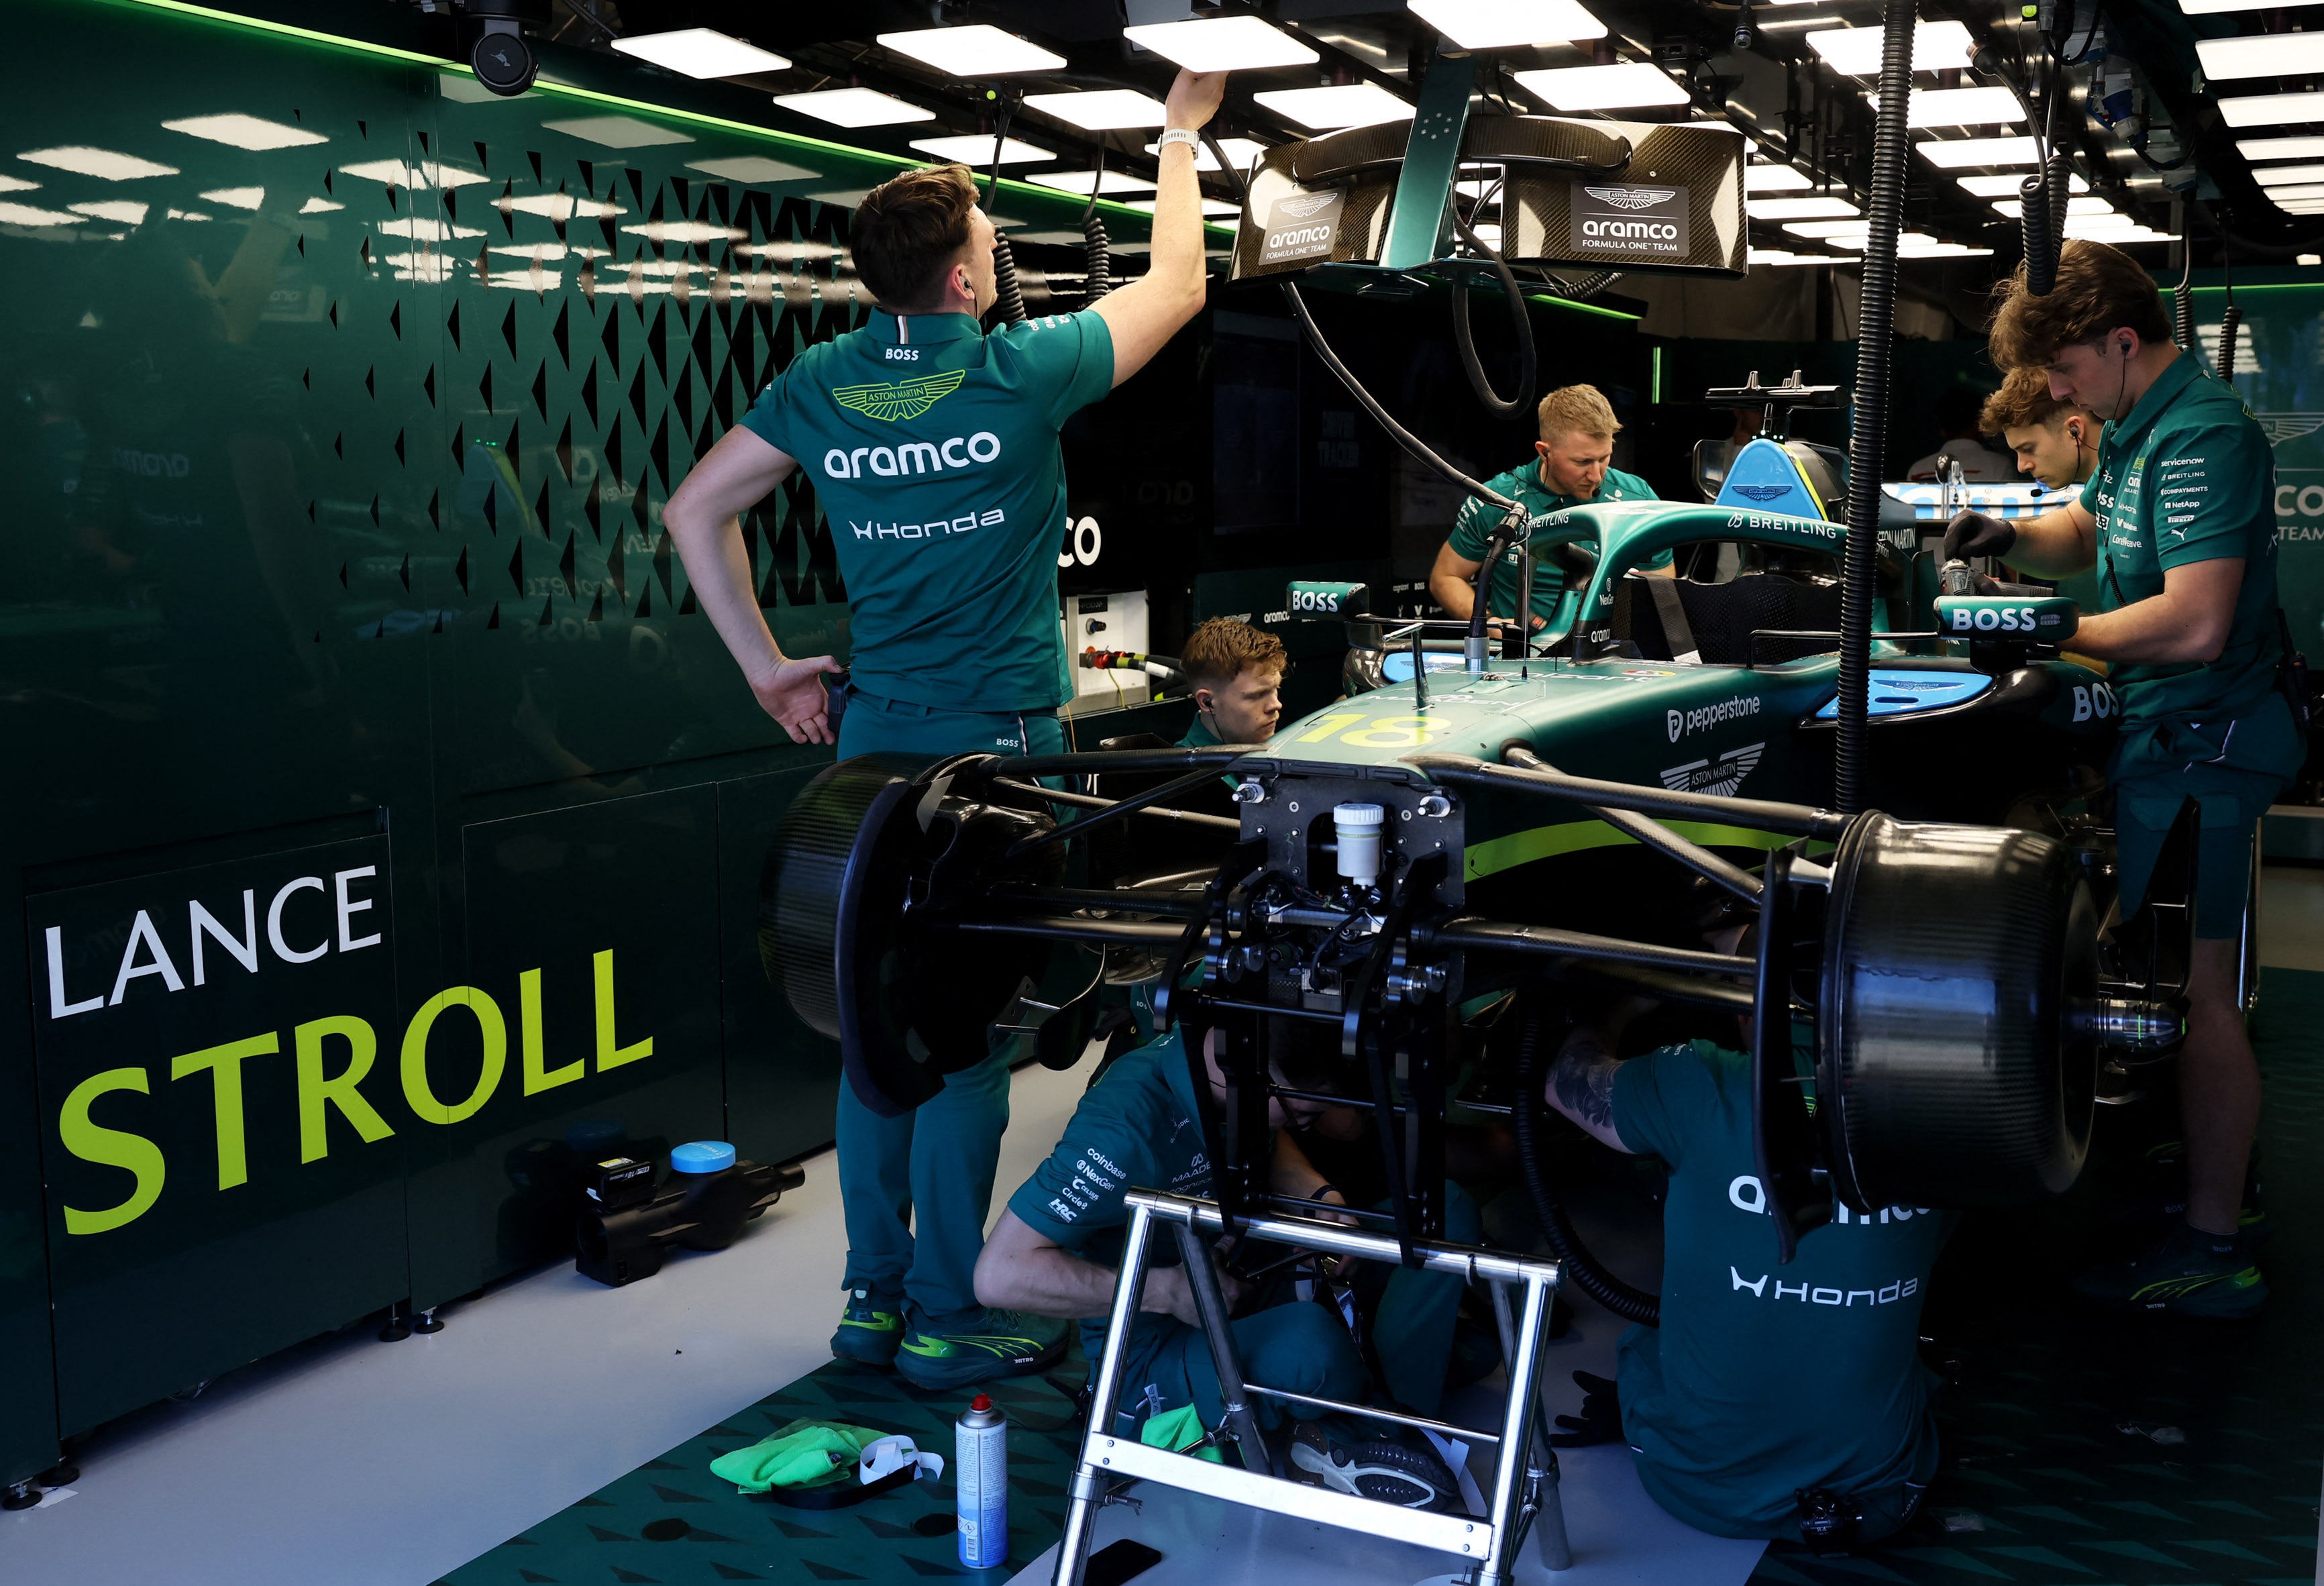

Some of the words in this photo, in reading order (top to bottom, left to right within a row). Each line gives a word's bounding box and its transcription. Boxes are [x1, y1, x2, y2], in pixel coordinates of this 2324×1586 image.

[1269, 225, 1330, 248] aramco
[1583, 220, 1677, 240] aramco
[1266, 248, 1293, 260] FORMULA
[1310, 243, 1327, 253] TEAM
[1582, 240, 1626, 249] FORMULA
[1652, 243, 1677, 251] TEAM
[885, 348, 920, 361] BOSS
[867, 391, 896, 402] ASTON
[897, 386, 925, 399] MARTIN
[824, 431, 1002, 478] aramco
[2161, 458, 2205, 467] servicenow
[2167, 472, 2205, 480] BREITLING
[2164, 486, 2209, 495] COINPAYMENTS
[2172, 500, 2200, 509] NetApp
[876, 509, 1005, 539] Honda
[1527, 512, 1571, 529] BREITLING
[1749, 516, 1836, 539] BREITLING
[2167, 515, 2195, 523] PIRELLI
[1894, 527, 1916, 549] MARTIN
[1292, 590, 1338, 613] BOSS
[1952, 607, 2036, 631] BOSS
[1687, 695, 1760, 736] pepperstone
[996, 737, 1019, 748] BOSS
[1295, 713, 1452, 749] 18
[1691, 769, 1711, 786] ASTON
[1712, 761, 1736, 780] MARTIN
[45, 865, 382, 1020] LANCE
[59, 948, 653, 1236] STROLL
[1087, 1148, 1127, 1179] coinbase
[1082, 1165, 1115, 1192] NexGen
[1049, 1198, 1077, 1222] HRC
[1775, 1277, 1918, 1307] Honda
